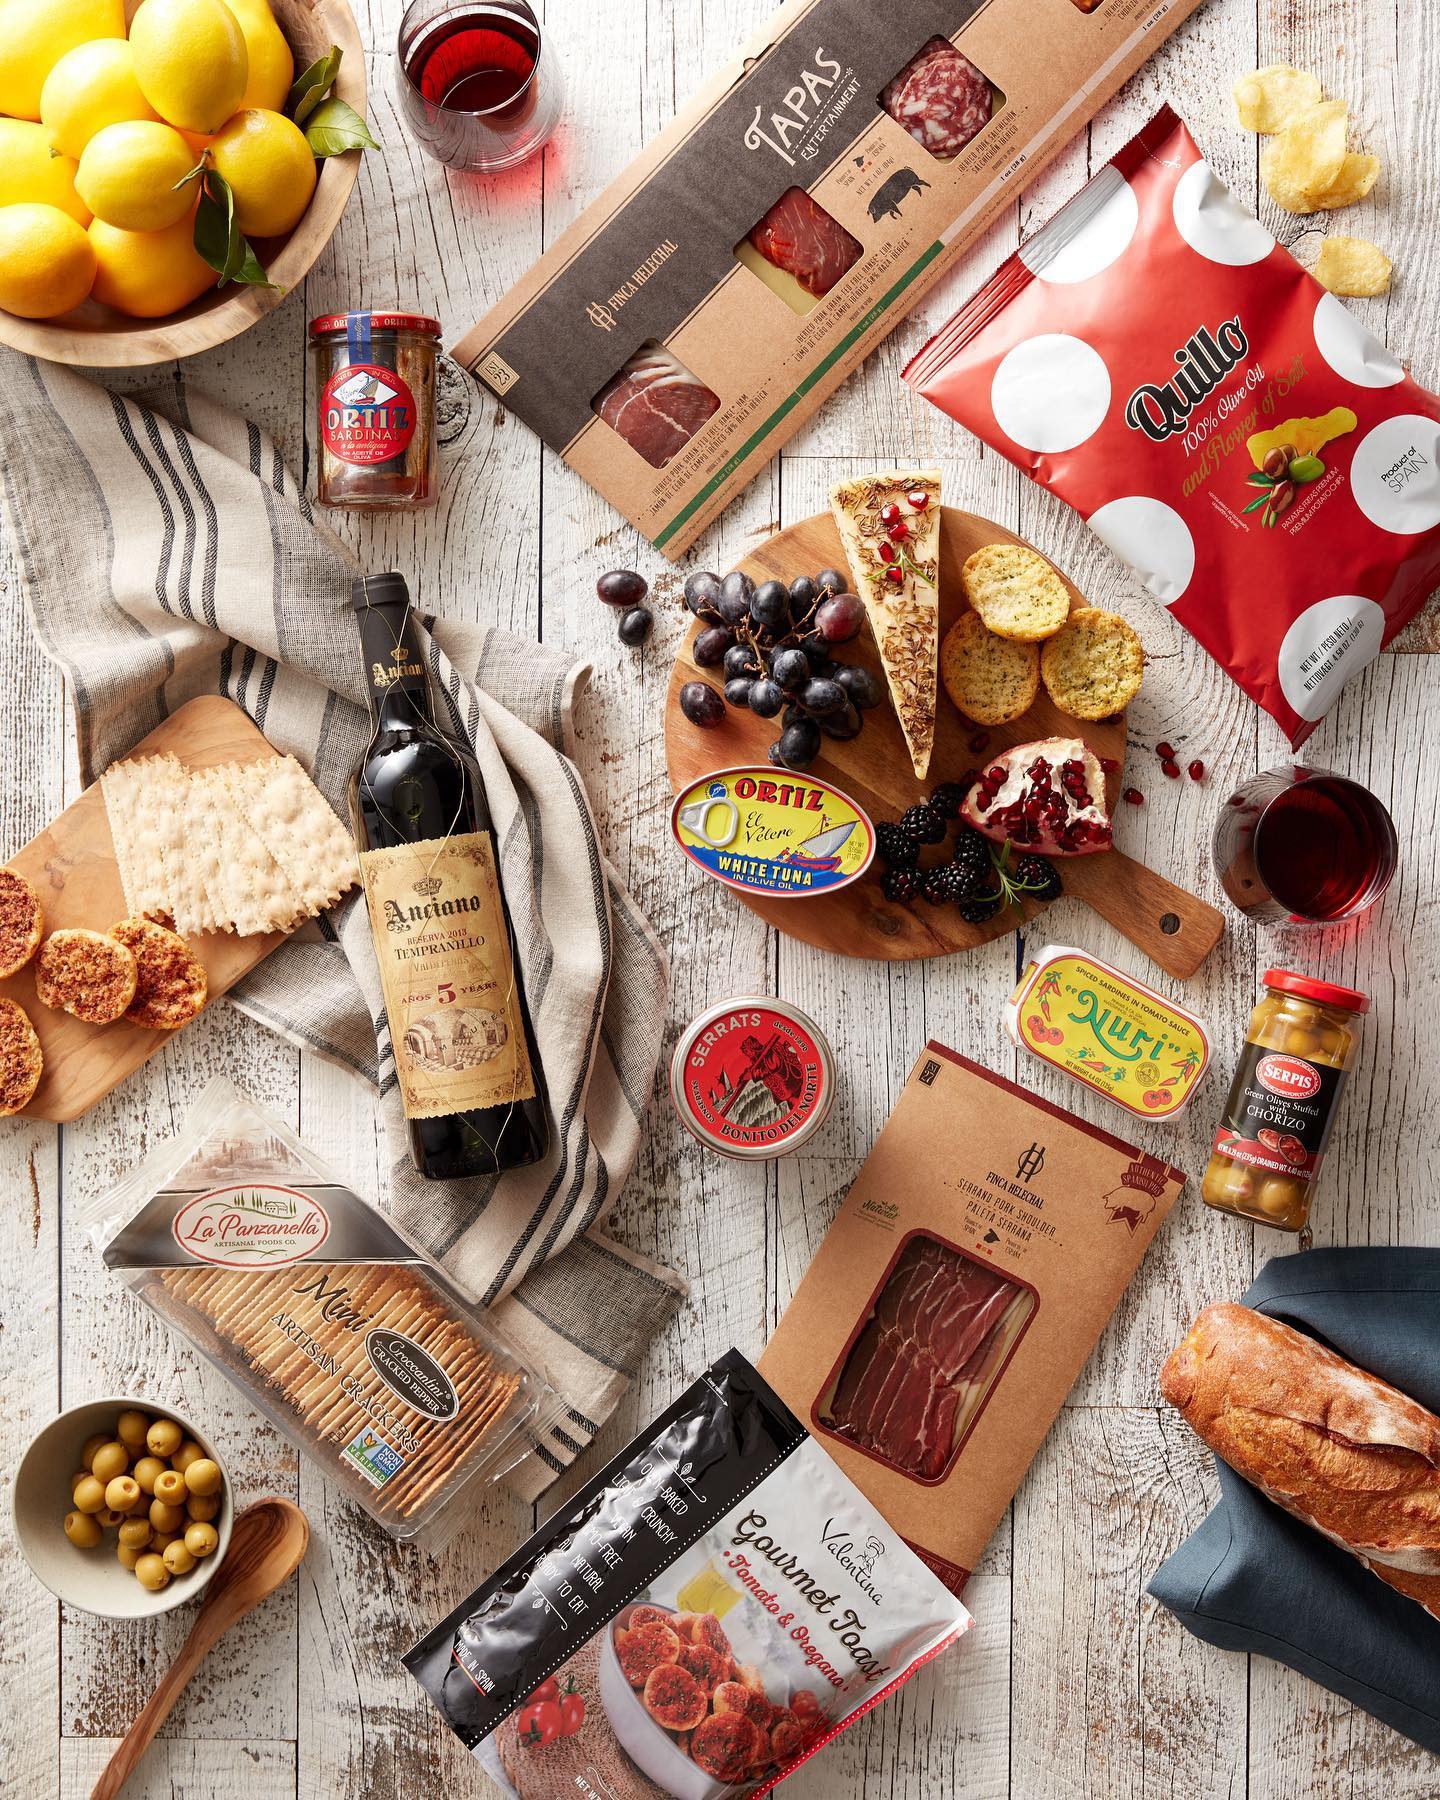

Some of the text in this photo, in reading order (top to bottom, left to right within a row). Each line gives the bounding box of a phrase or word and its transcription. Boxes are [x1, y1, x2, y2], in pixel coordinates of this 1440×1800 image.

[744, 47, 841, 167] TAPAS
[801, 77, 861, 161] ENTERTAINMENT
[974, 137, 990, 153] PORK
[606, 236, 680, 311] FINCA HELECHAL
[812, 309, 828, 325] PORK
[849, 270, 865, 286] FREE
[806, 338, 816, 348] DE
[825, 318, 835, 328] DE
[831, 301, 851, 321] CAMPO
[492, 367, 511, 386] 23
[1124, 314, 1250, 442] Quillo
[327, 406, 408, 430] ORTIZ
[1180, 362, 1266, 457] 100% Olive Oil
[1181, 452, 1213, 496] and
[1209, 407, 1261, 469] Flower
[1260, 381, 1277, 414] of
[1276, 354, 1308, 398] Salt
[668, 461, 684, 477] PORK
[705, 422, 721, 438] FREE
[1380, 445, 1417, 482] Product of
[663, 489, 674, 499] DE
[682, 469, 693, 479] DE
[689, 452, 709, 472] CAMPO
[1387, 452, 1427, 494] SPAIN
[1280, 466, 1339, 530] PATATAS FRITAS PREMIUM
[1288, 473, 1345, 536] PREMIUM POTATO CHIPS
[1298, 620, 1350, 674] NET WT PESO NETO
[735, 777, 825, 811] ORTIZ
[744, 827, 794, 844] Velero
[746, 811, 763, 828] El
[718, 856, 813, 886] WHITE TUNA
[733, 873, 794, 890] IN OLIVE OIL
[383, 894, 481, 933] Anciano
[394, 934, 485, 960] TEMPRANILLO
[406, 927, 467, 945] RESERVA 2013
[400, 980, 497, 1005] AÑOS 5 YEARS
[1074, 965, 1099, 983] SPICED
[1097, 978, 1131, 1001] SARDINES
[1130, 997, 1140, 1007] IN
[1139, 1003, 1168, 1023] TOMATO
[1167, 1019, 1190, 1036] SAUCE
[691, 1013, 762, 1068] SERRATS
[773, 1021, 809, 1052] desde 1890
[920, 1069, 935, 1084] 27
[1064, 1059, 1073, 1067] NET
[1071, 1063, 1089, 1076] WEIGHT
[1263, 1064, 1313, 1090] SERPIS
[691, 1079, 716, 1123] CONSERVAS
[721, 1062, 818, 1142] BONITO DEL NORTE
[1243, 1086, 1319, 1116] Green Olives Stuffed
[1245, 1104, 1306, 1131] CHORIZO
[1268, 1102, 1288, 1115] with
[956, 1177, 1057, 1237] SERRANO PORK SHOULDER
[985, 1170, 1046, 1209] FINCA HELECHAL
[184, 1213, 318, 1242] La Panzanella
[965, 1200, 996, 1223] PALETA
[995, 1216, 1033, 1242] SERRANA
[213, 1239, 255, 1247] ARTISANAL
[294, 1275, 374, 1334] Mini
[268, 1309, 422, 1455] ARTISAN CRACKERS
[370, 1345, 442, 1414] CRACKED PEPPER
[386, 1337, 449, 1399] Croccantini
[349, 1446, 385, 1481] VERIFIED
[372, 1457, 390, 1475] Project
[377, 1452, 395, 1471] GMO
[382, 1447, 400, 1465] NON
[639, 1505, 678, 1545] CRUNCHY
[533, 1551, 589, 1616] READY TO EAT
[556, 1537, 606, 1594] ALL NATURAL
[820, 1518, 883, 1607] Valentina
[731, 1509, 890, 1682] Gourmet Toast
[726, 1552, 844, 1687] Tomato & Oregano
[451, 1639, 496, 1693] MADE IN SPAIN
[573, 1774, 591, 1793] NET
